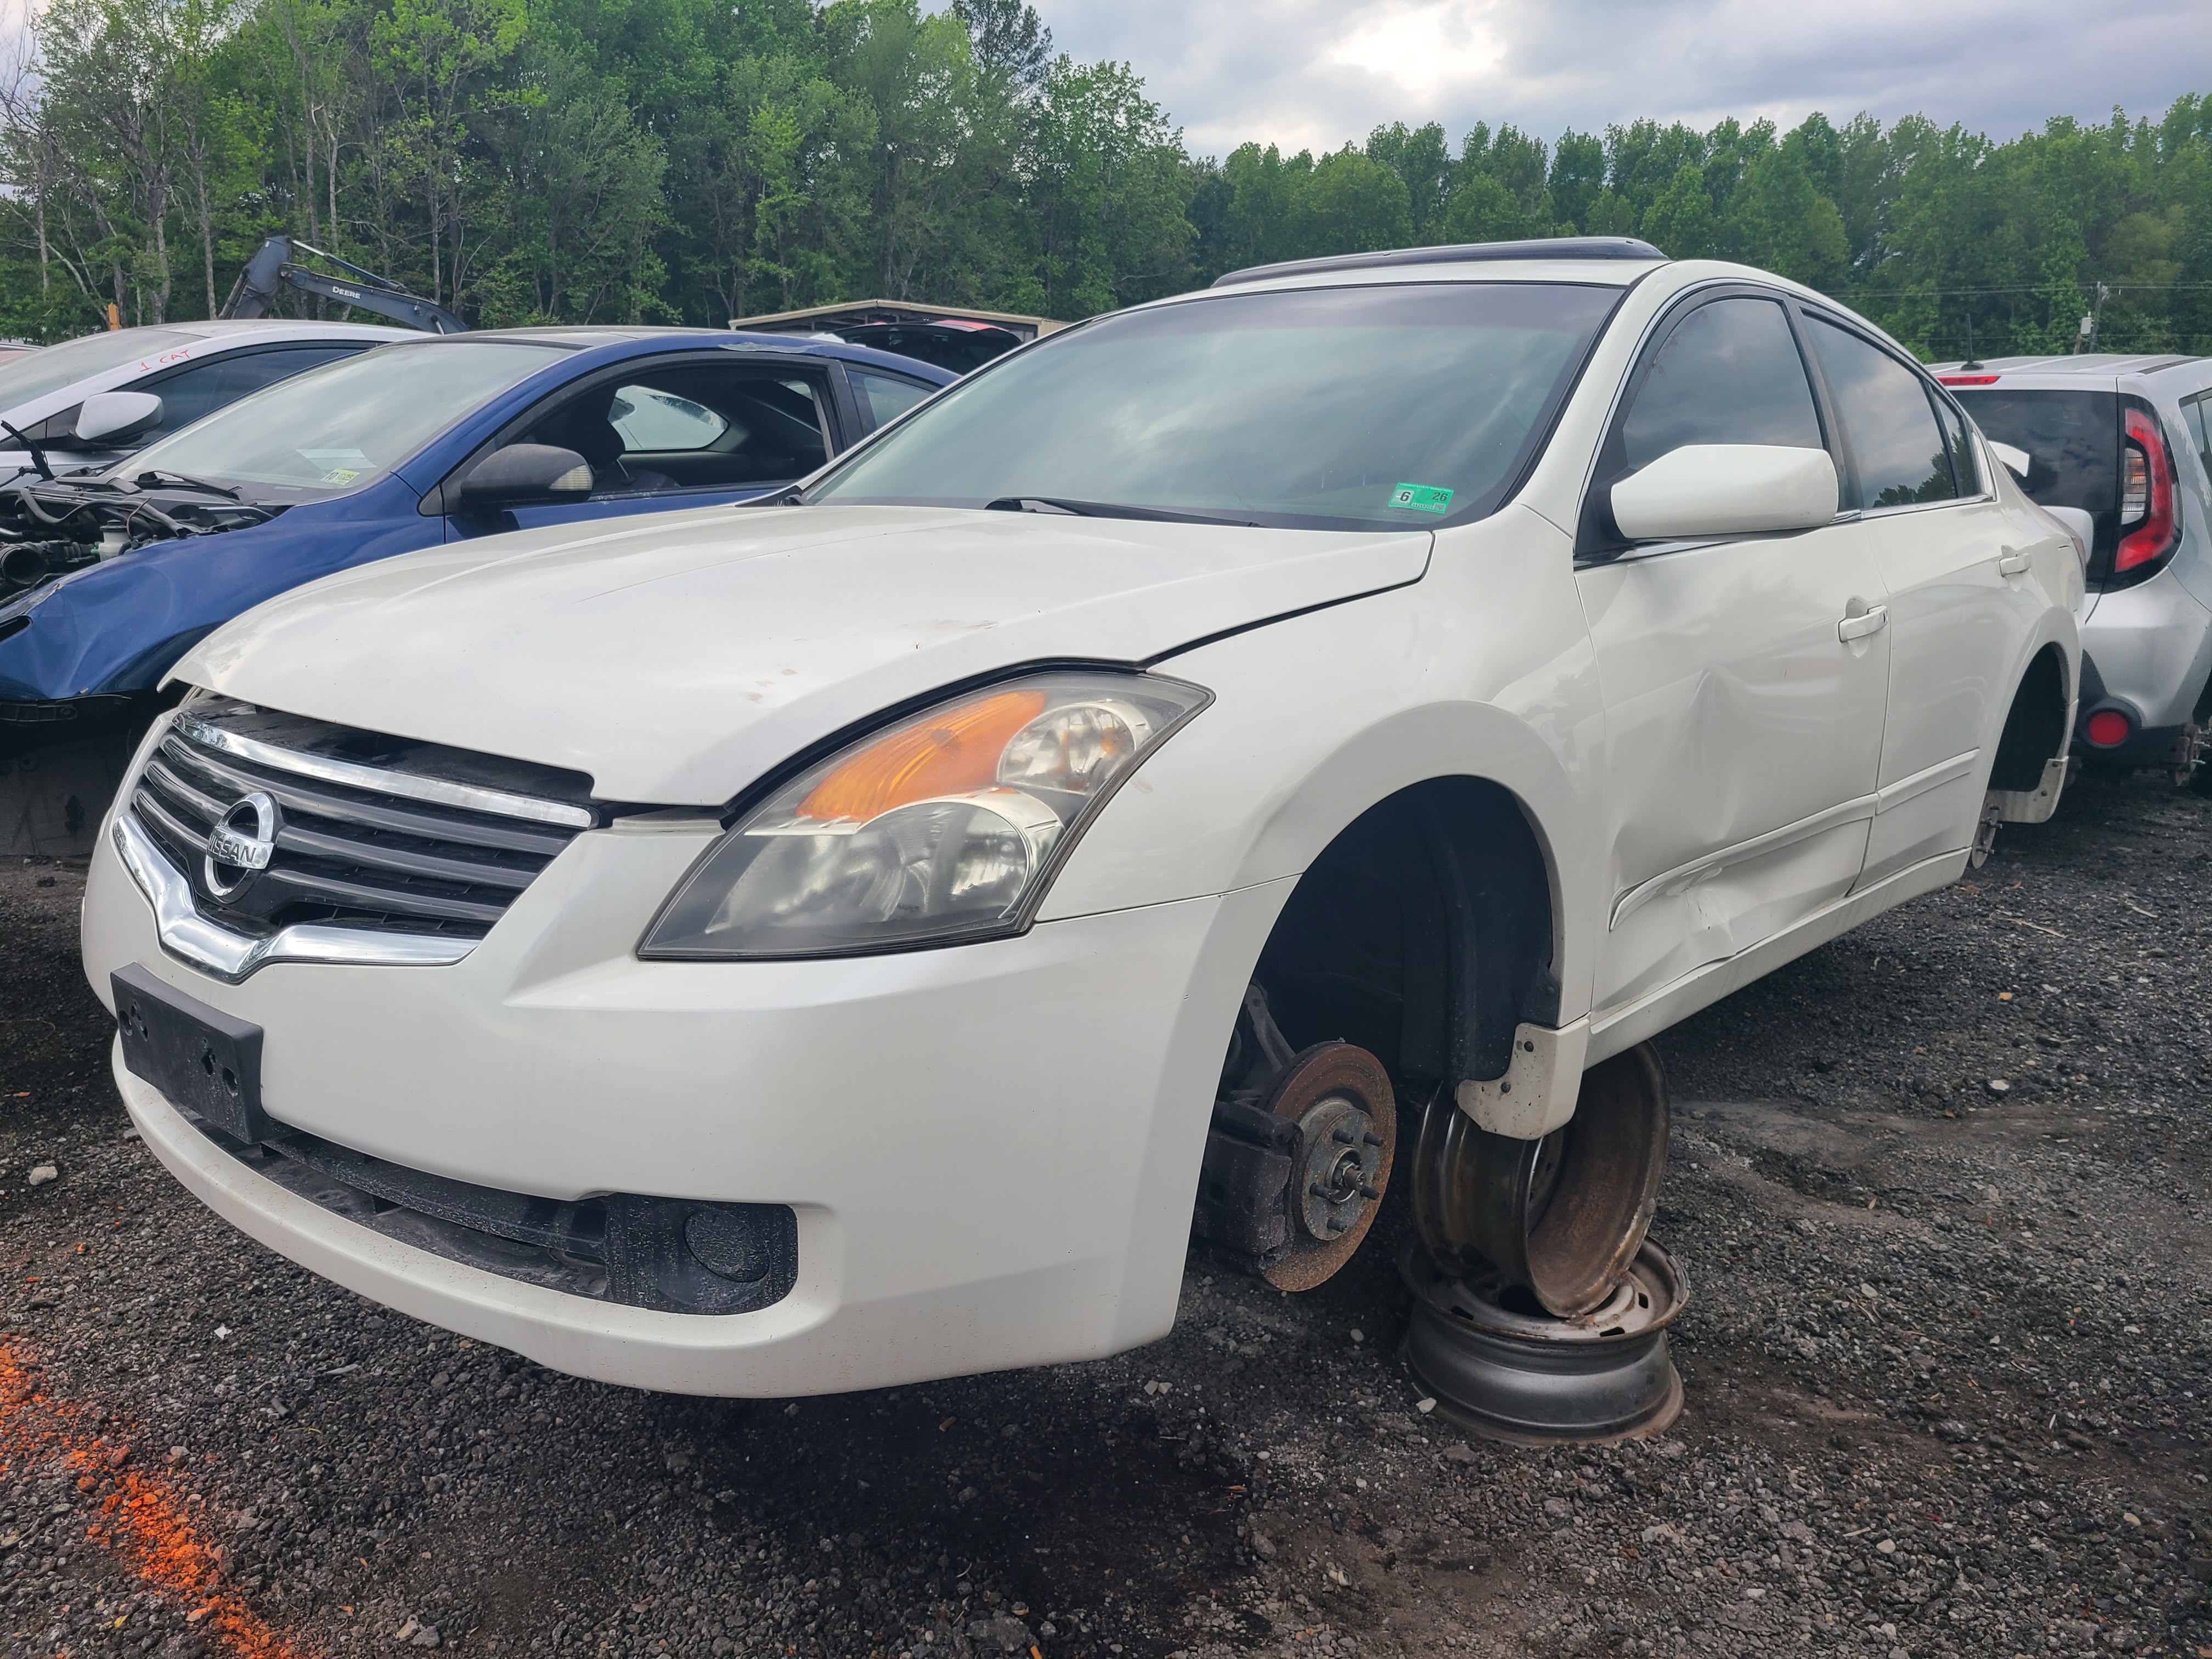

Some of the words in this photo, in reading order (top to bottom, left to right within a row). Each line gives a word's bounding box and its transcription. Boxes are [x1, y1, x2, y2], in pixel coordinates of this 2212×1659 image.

[332, 285, 362, 300] DEERE
[140, 362, 153, 372] 1
[159, 349, 190, 363] CAT
[1400, 492, 1411, 501] 6
[1432, 492, 1448, 501] 26
